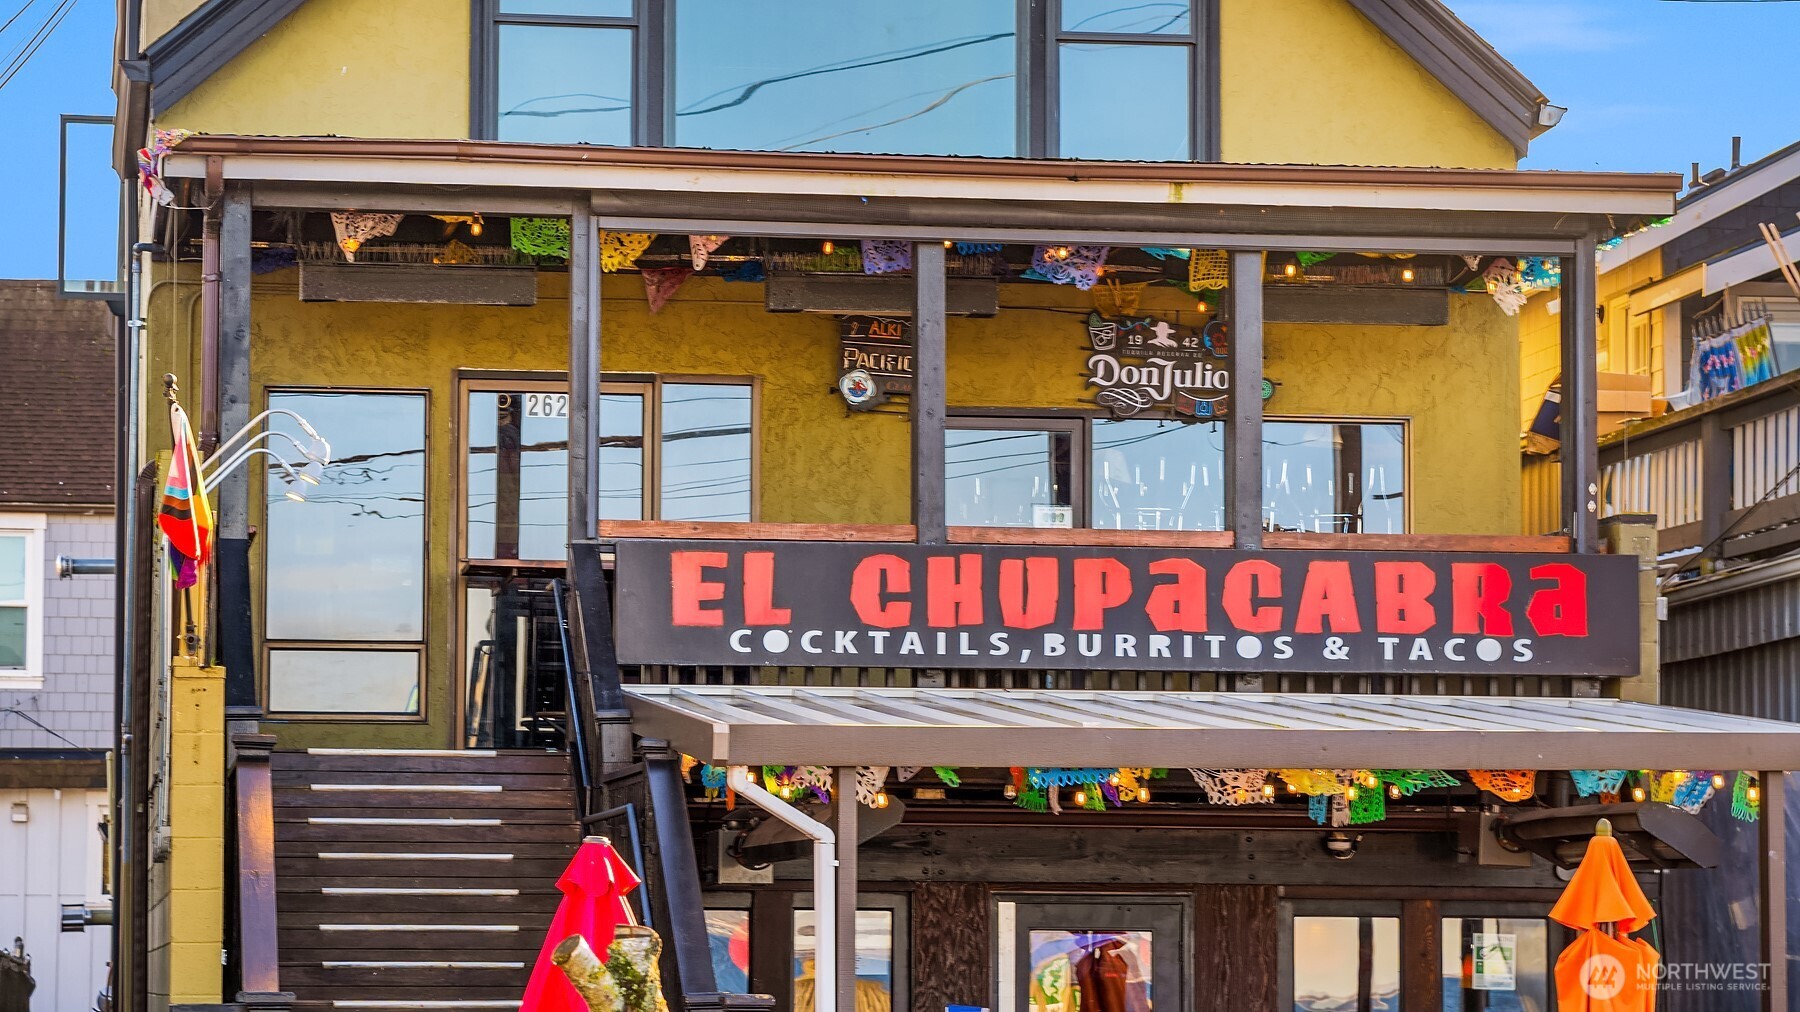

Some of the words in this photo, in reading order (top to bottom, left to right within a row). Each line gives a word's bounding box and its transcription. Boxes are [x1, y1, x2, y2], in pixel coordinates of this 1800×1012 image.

[868, 320, 902, 336] ALKI
[1127, 334, 1144, 345] 19
[1181, 337, 1200, 348] 42
[528, 394, 567, 417] 262
[670, 550, 792, 627] EL
[1322, 636, 1350, 661] &
[1377, 637, 1534, 662] TACOS
